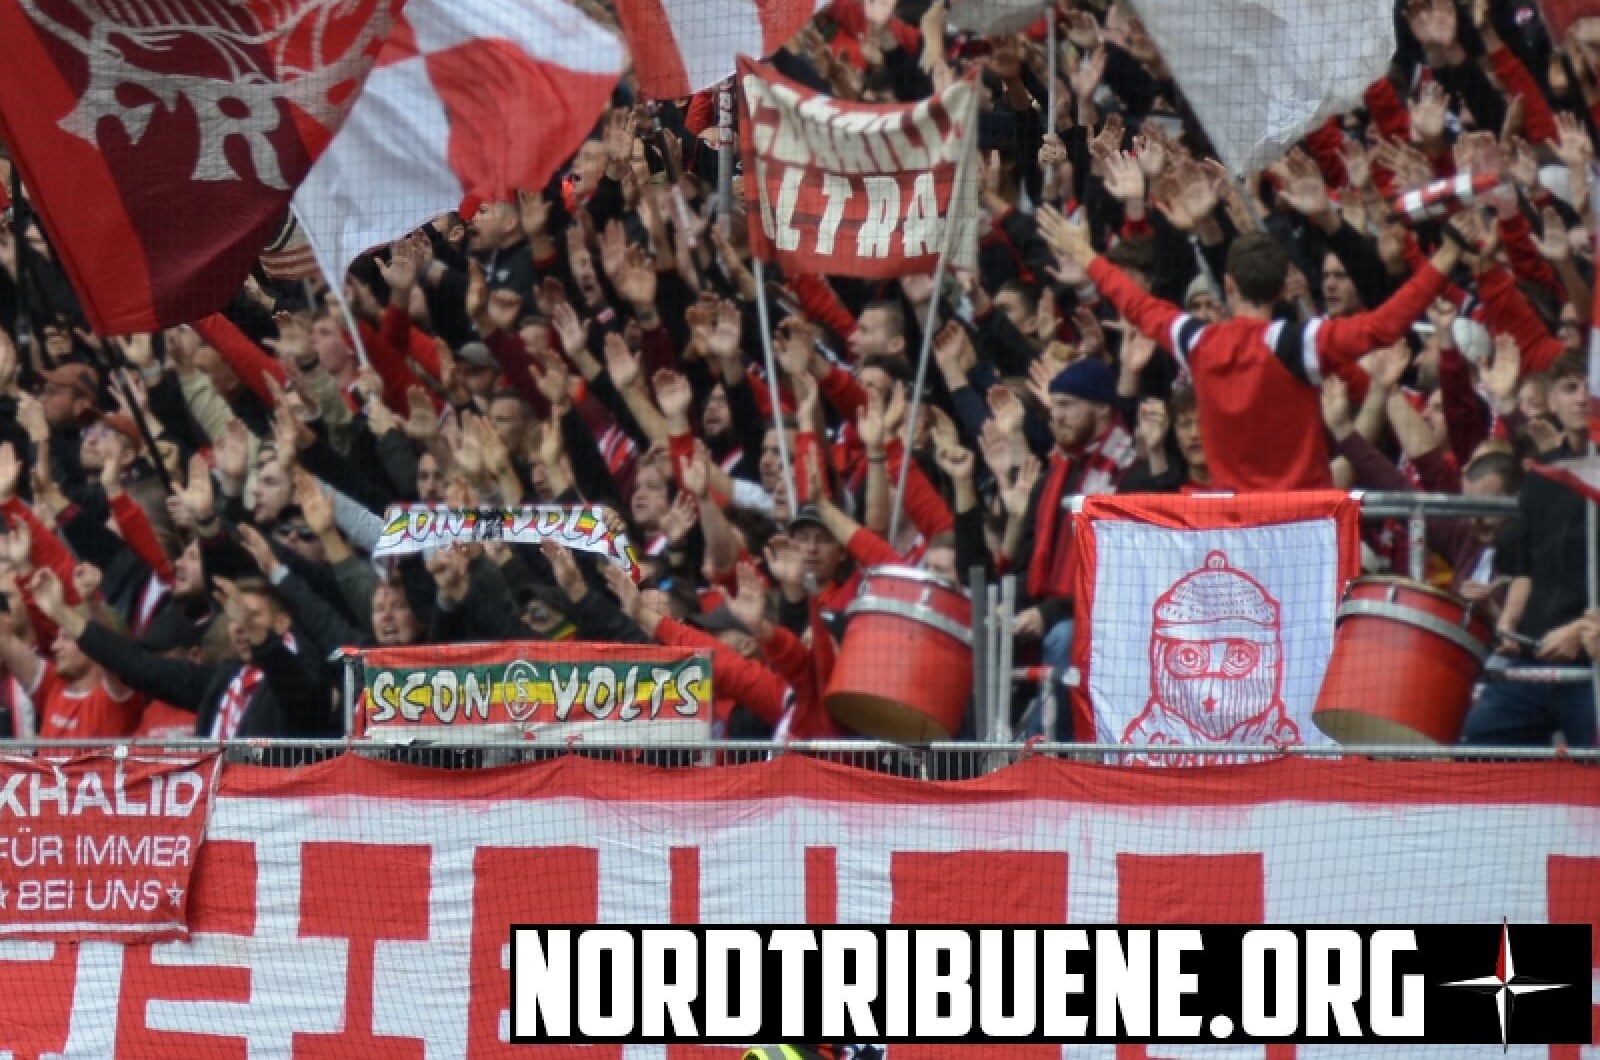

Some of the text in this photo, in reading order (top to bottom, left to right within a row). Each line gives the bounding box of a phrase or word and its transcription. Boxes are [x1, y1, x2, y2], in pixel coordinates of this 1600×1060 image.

[371, 670, 492, 724] SCON
[550, 666, 703, 723] VOLTS
[75, 834, 192, 867] IMMER
[17, 879, 163, 911] BEI UNS
